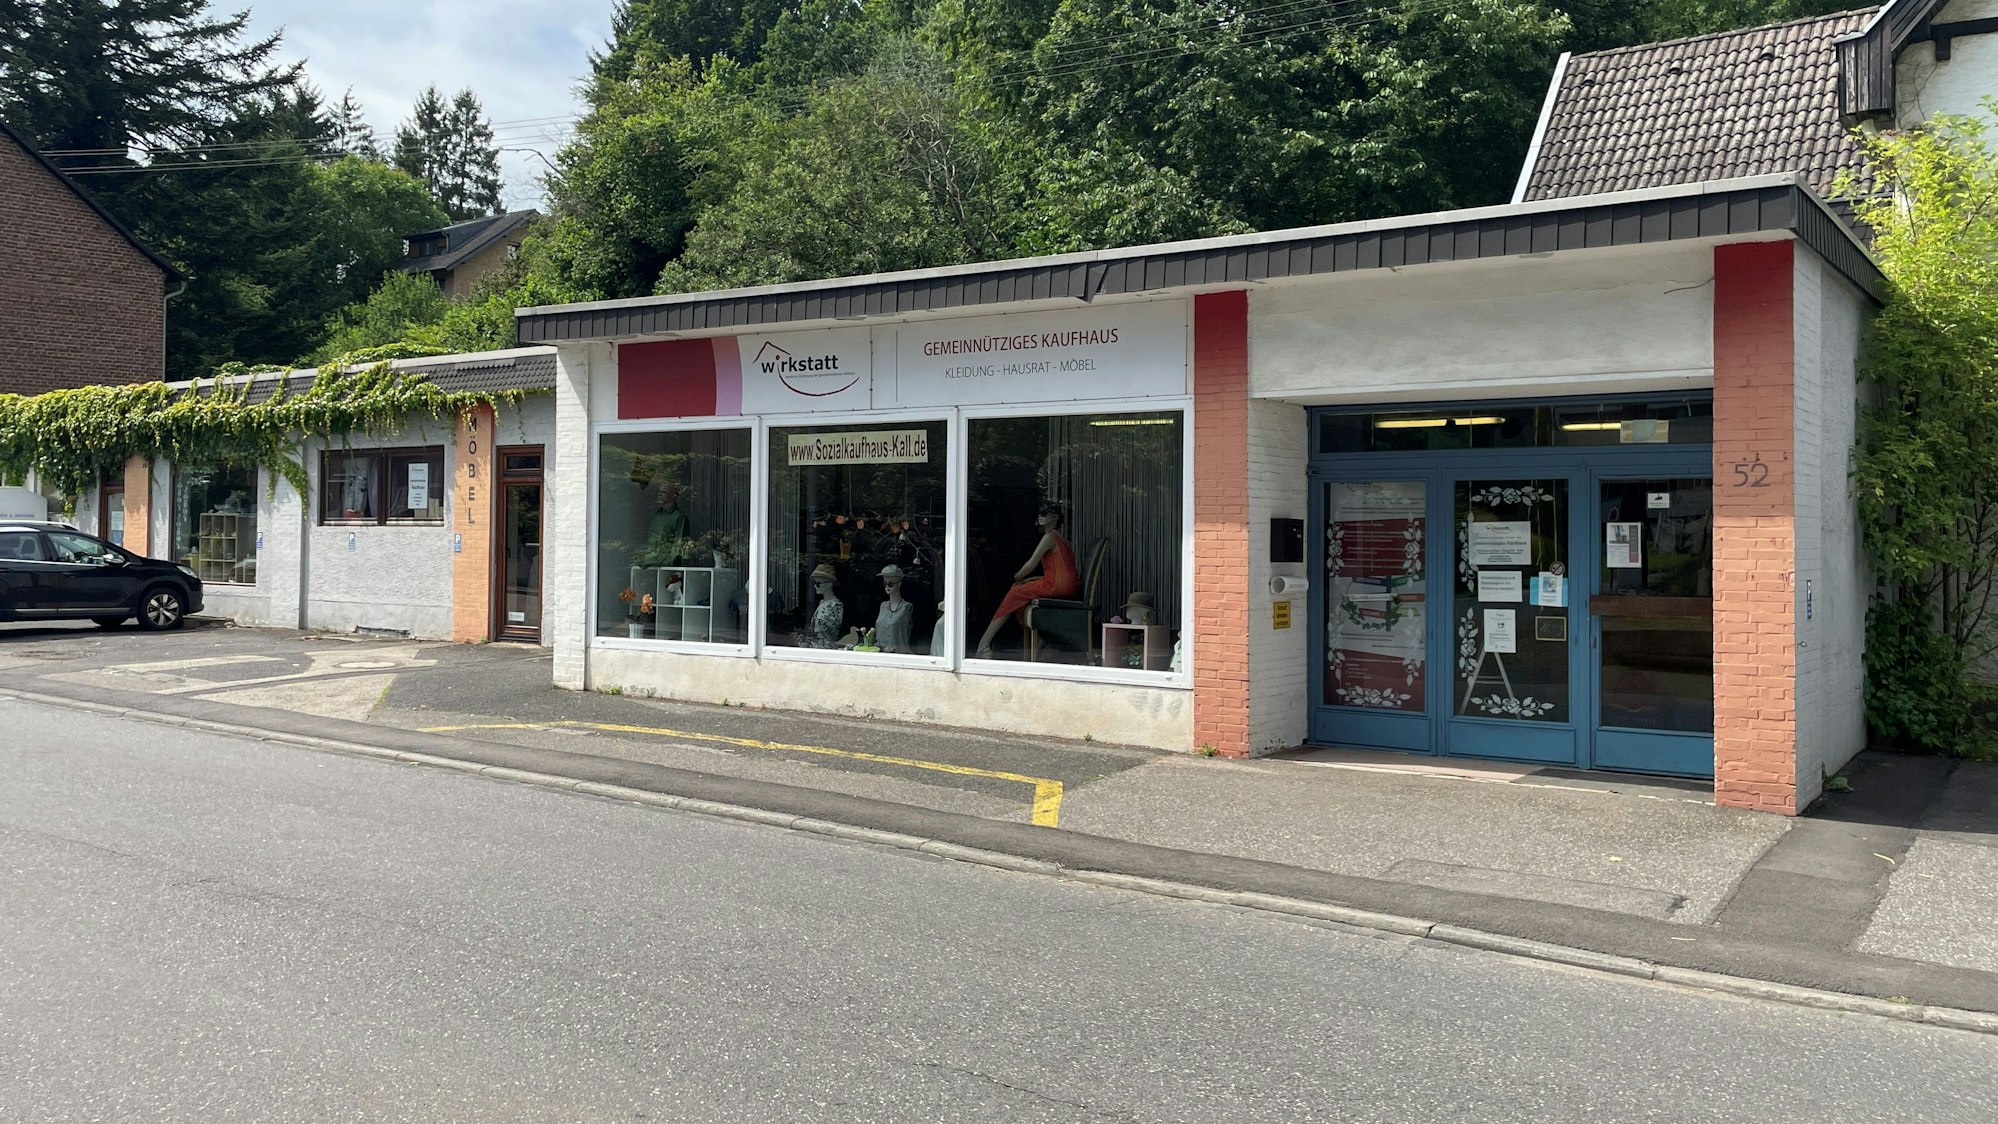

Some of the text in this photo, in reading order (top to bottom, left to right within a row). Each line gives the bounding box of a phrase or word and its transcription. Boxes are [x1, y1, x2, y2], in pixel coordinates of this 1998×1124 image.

[924, 328, 1119, 356] GEMEINNÜTZIGES KAUFHAUS
[761, 355, 839, 374] wirkstatt
[945, 365, 995, 379] KLEIDUNG
[1003, 361, 1052, 376] HAUSRAT
[1060, 358, 1097, 372] MÖBEL
[790, 434, 926, 461] www.Sozialkaufhaus-Kall.de
[1732, 463, 1772, 488] 52
